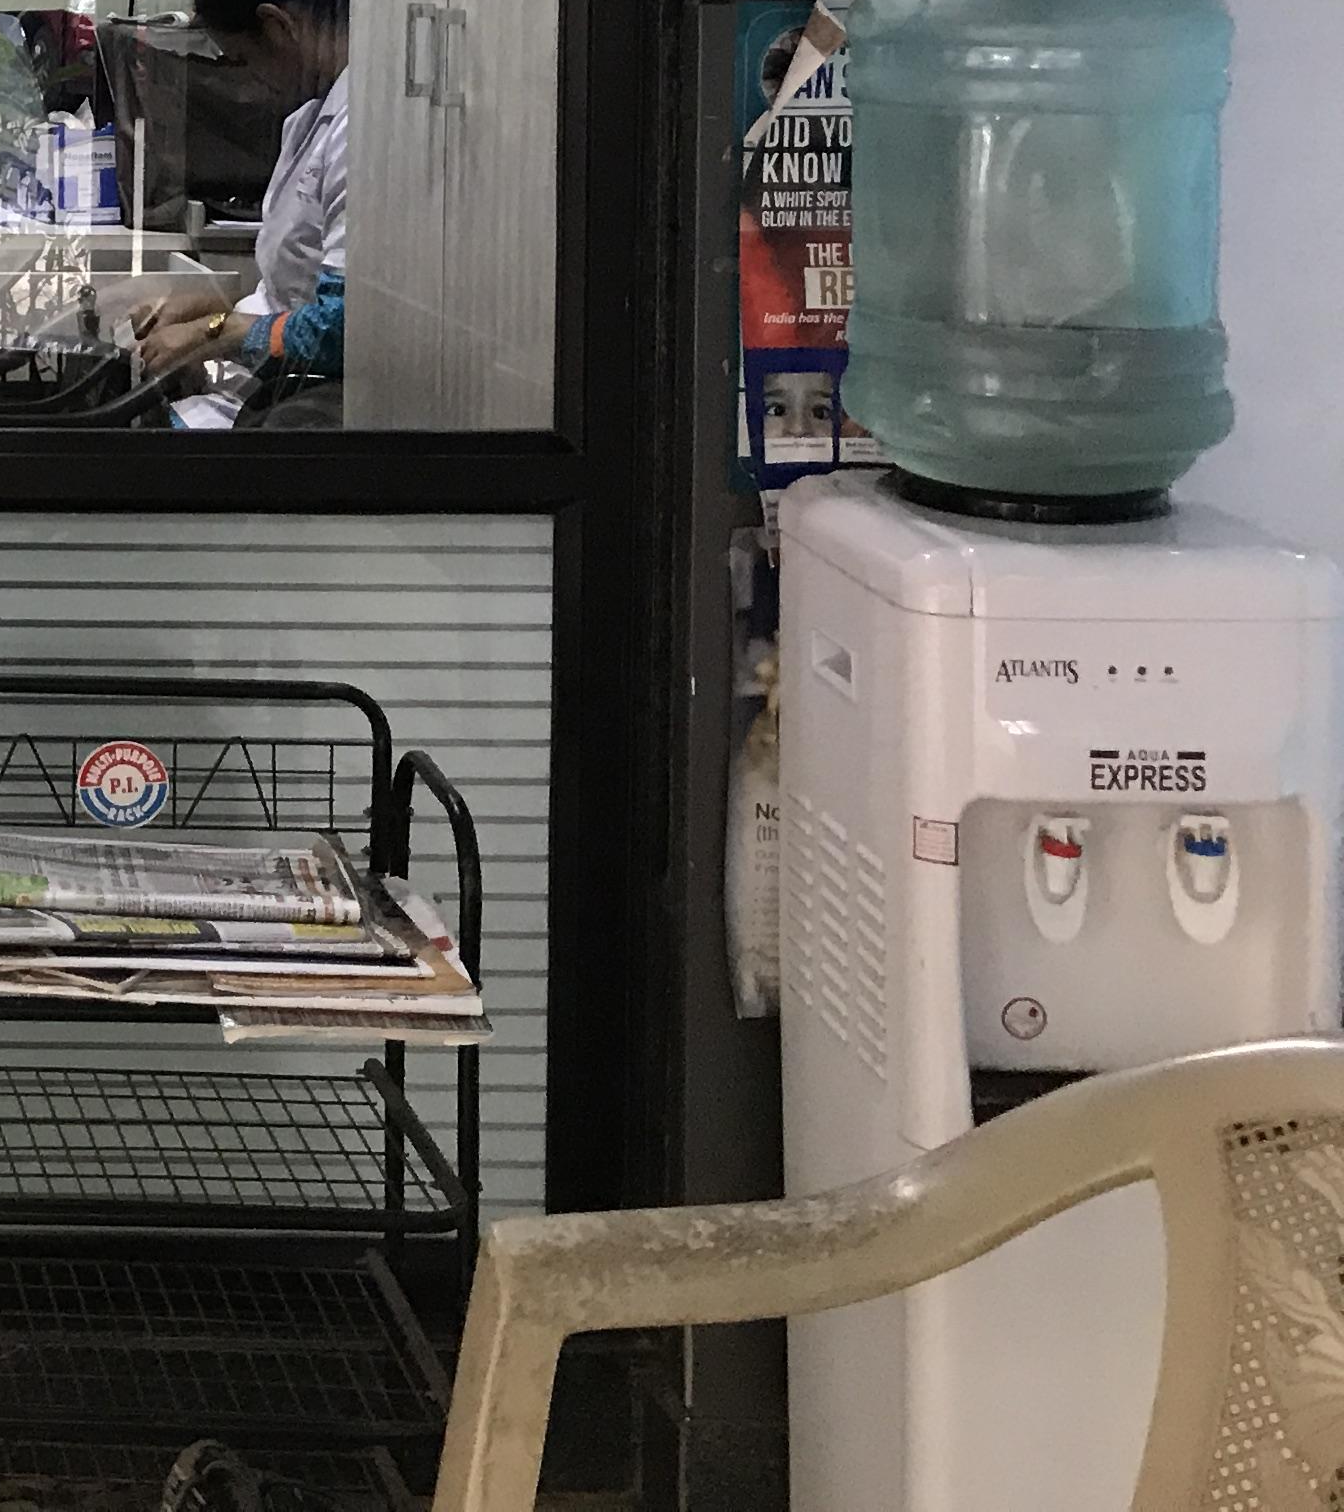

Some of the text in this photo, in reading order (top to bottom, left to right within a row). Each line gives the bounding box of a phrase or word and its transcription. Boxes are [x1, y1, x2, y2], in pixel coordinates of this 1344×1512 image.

[765, 117, 852, 148] DID YO
[762, 151, 842, 184] KNOW
[762, 191, 847, 208] A WHITE SPOT
[762, 210, 842, 227] GLOW IN THE
[806, 243, 843, 265] THE
[764, 313, 844, 325] India has the
[996, 659, 1079, 684] ATLANTIS
[1127, 749, 1170, 761] AQUA
[1090, 764, 1207, 792] EXPRESS
[107, 805, 144, 822] RACK
